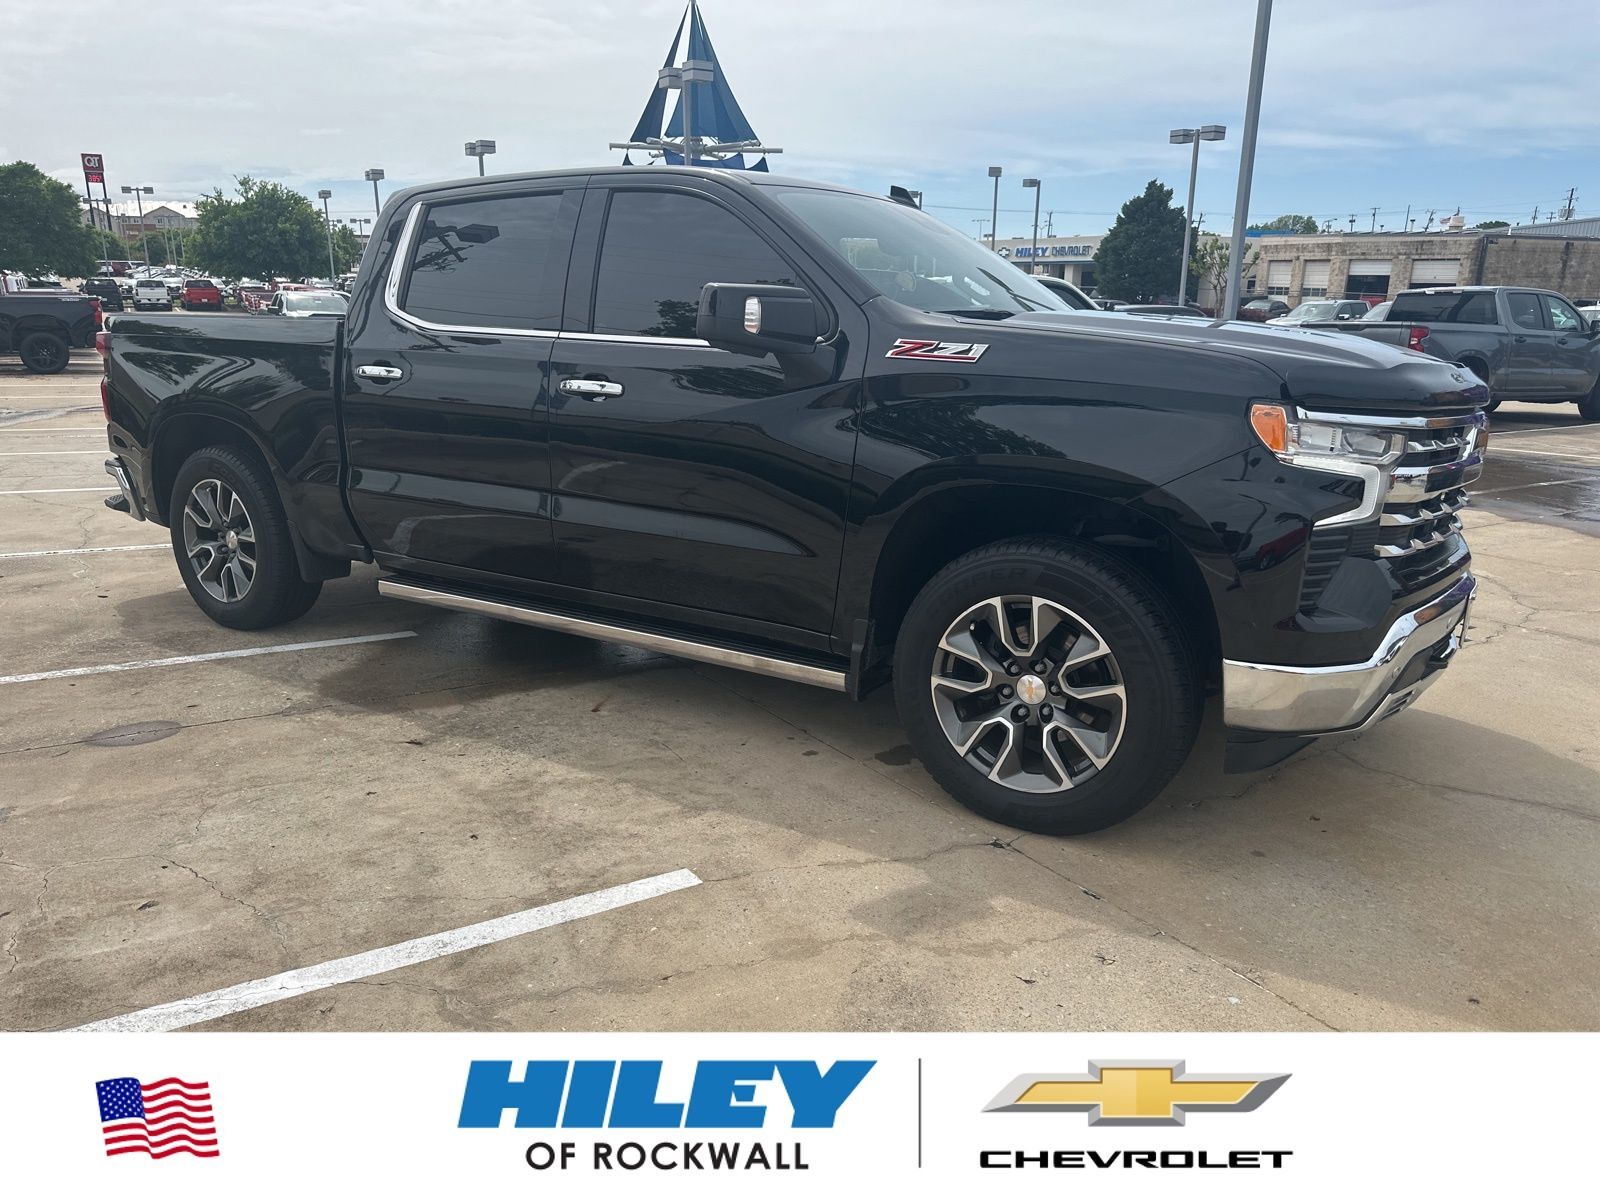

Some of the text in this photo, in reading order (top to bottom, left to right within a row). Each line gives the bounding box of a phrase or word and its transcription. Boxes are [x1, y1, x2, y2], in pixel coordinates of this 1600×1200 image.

[84, 156, 99, 168] QT
[1051, 245, 1093, 257] CHEVROLET
[885, 338, 990, 363] Z71
